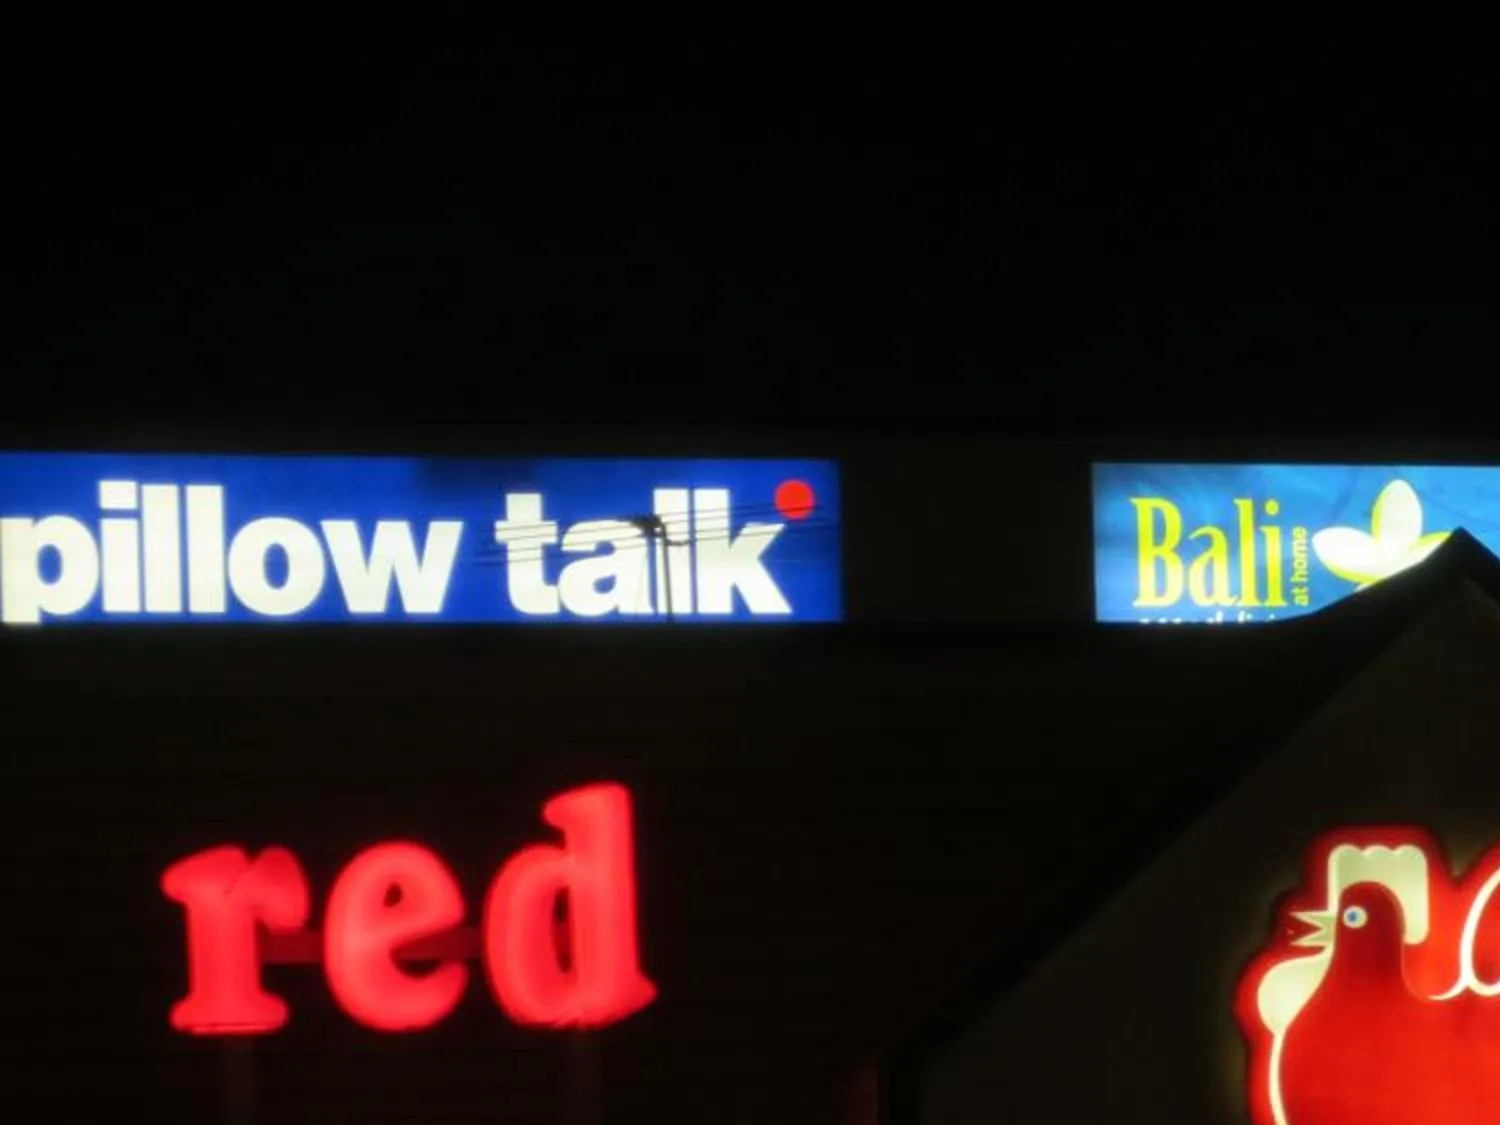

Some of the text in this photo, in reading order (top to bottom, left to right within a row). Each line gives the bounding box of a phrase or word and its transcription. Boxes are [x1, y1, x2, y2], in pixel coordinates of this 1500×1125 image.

[0, 479, 794, 624] pillow talk
[1130, 497, 1288, 607] Bali
[1290, 527, 1309, 606] at home
[160, 780, 657, 1036] red
